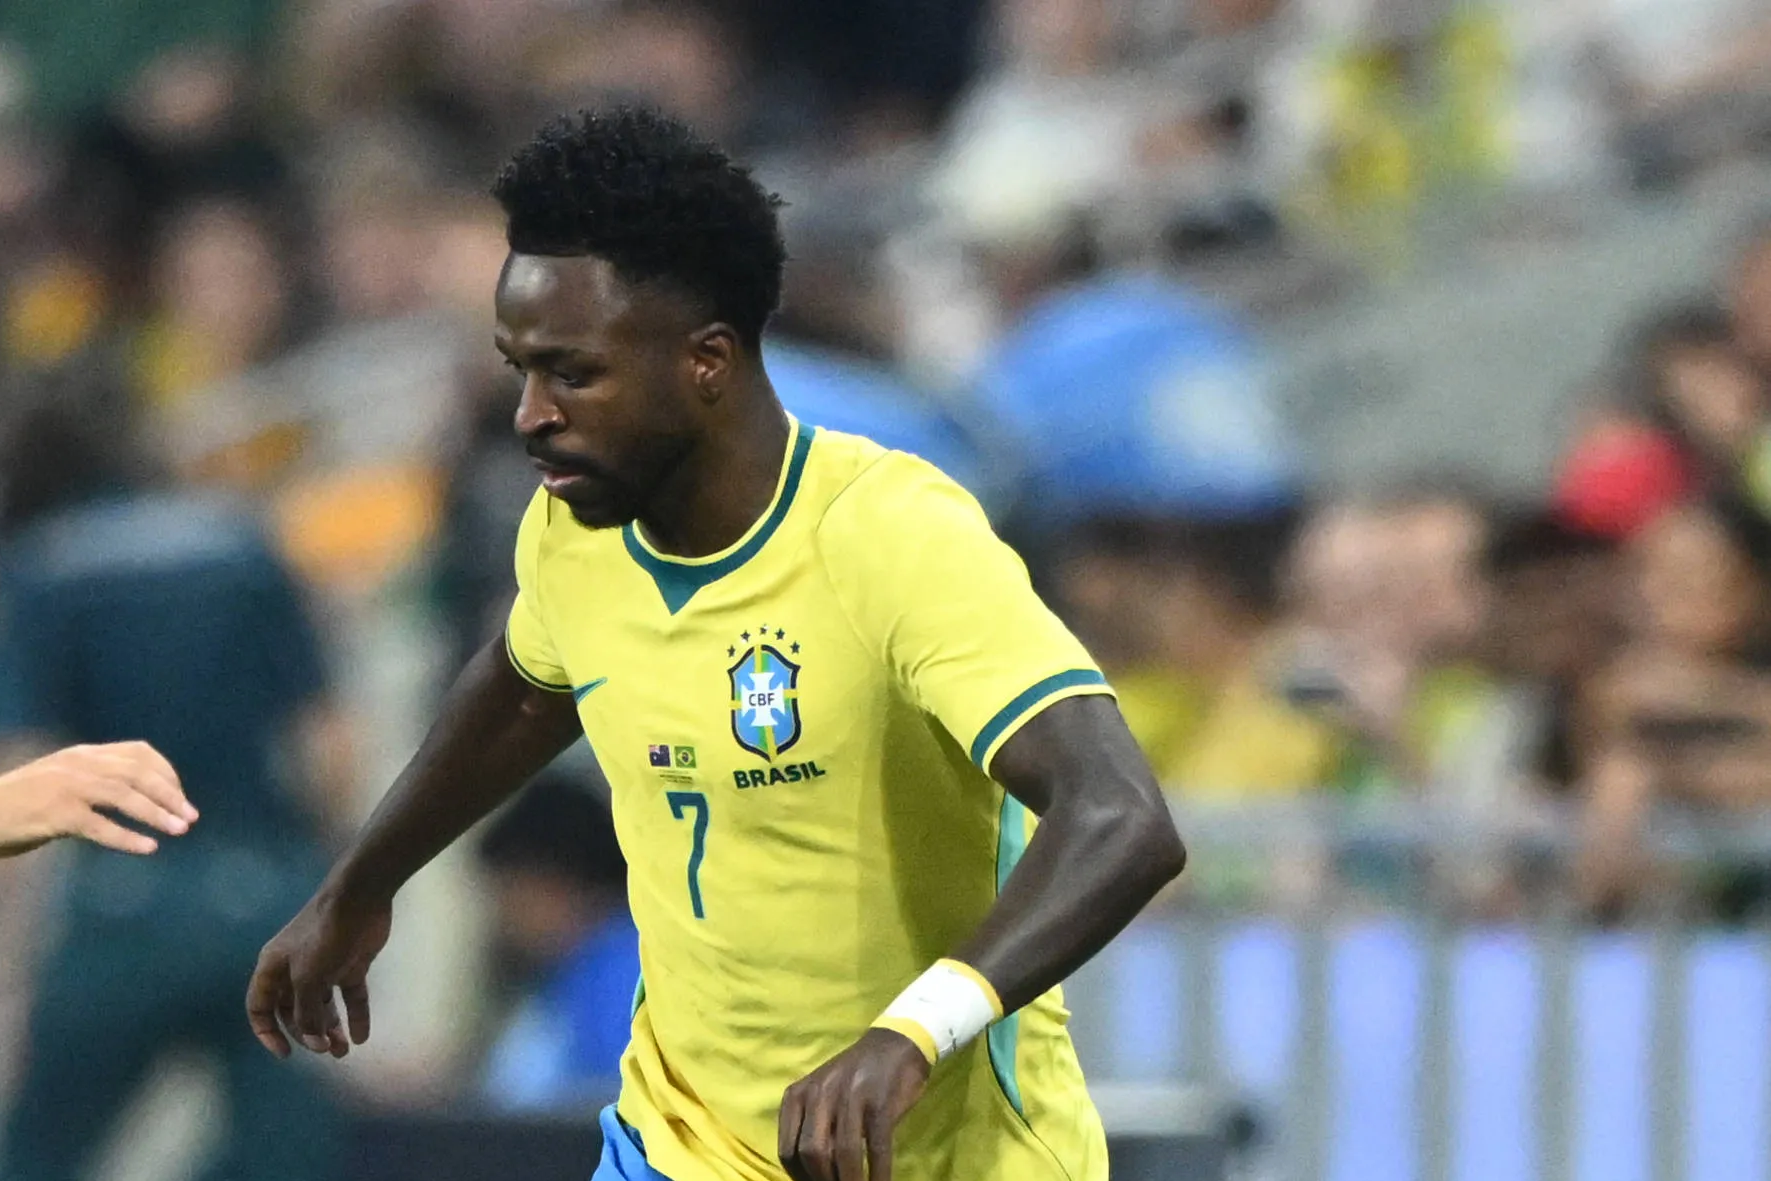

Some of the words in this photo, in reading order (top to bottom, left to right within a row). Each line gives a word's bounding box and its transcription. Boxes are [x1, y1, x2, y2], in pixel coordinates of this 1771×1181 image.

[748, 692, 775, 706] CBF
[733, 761, 826, 789] BRASIL
[665, 791, 710, 919] 7
